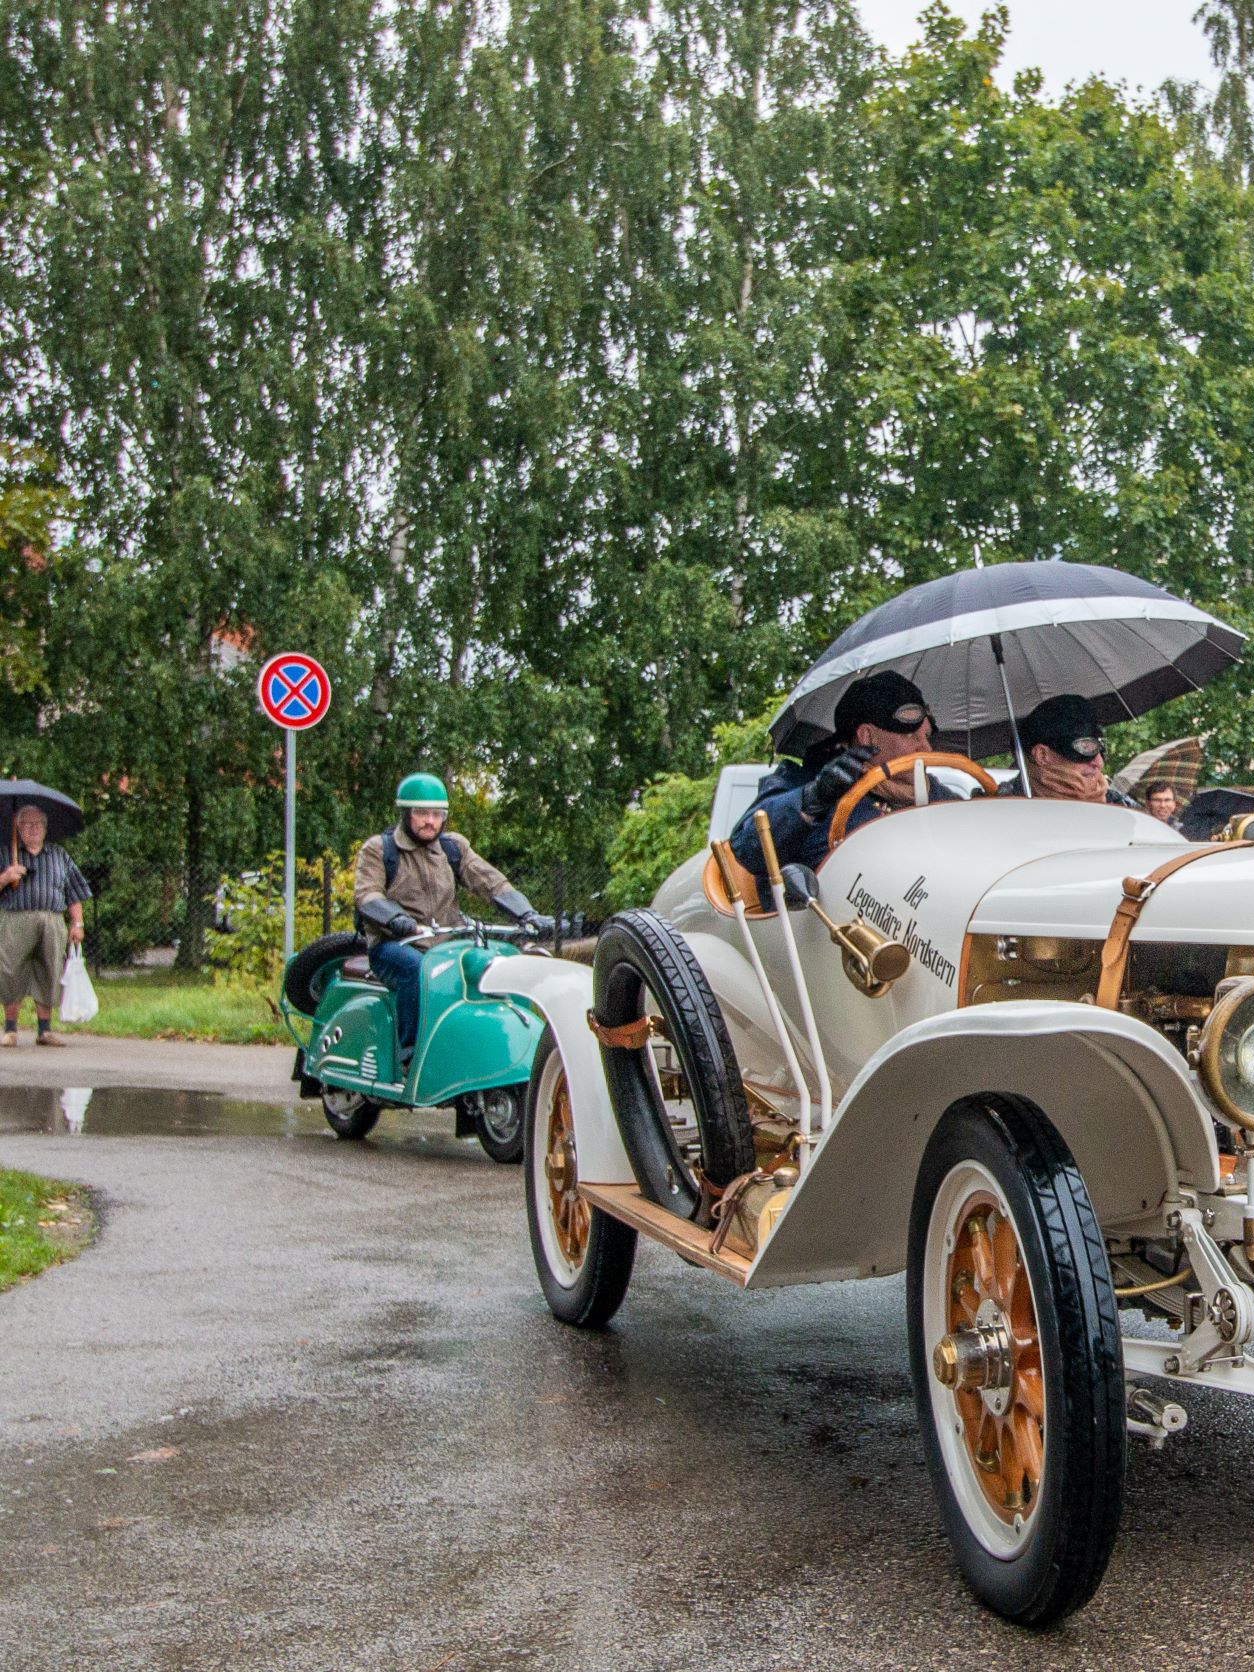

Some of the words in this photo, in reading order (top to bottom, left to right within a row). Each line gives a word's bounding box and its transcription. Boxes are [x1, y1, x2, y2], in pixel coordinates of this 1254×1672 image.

[846, 872, 902, 941] Legendäre
[902, 918, 957, 988] Nordstern
[903, 875, 929, 910] Der
